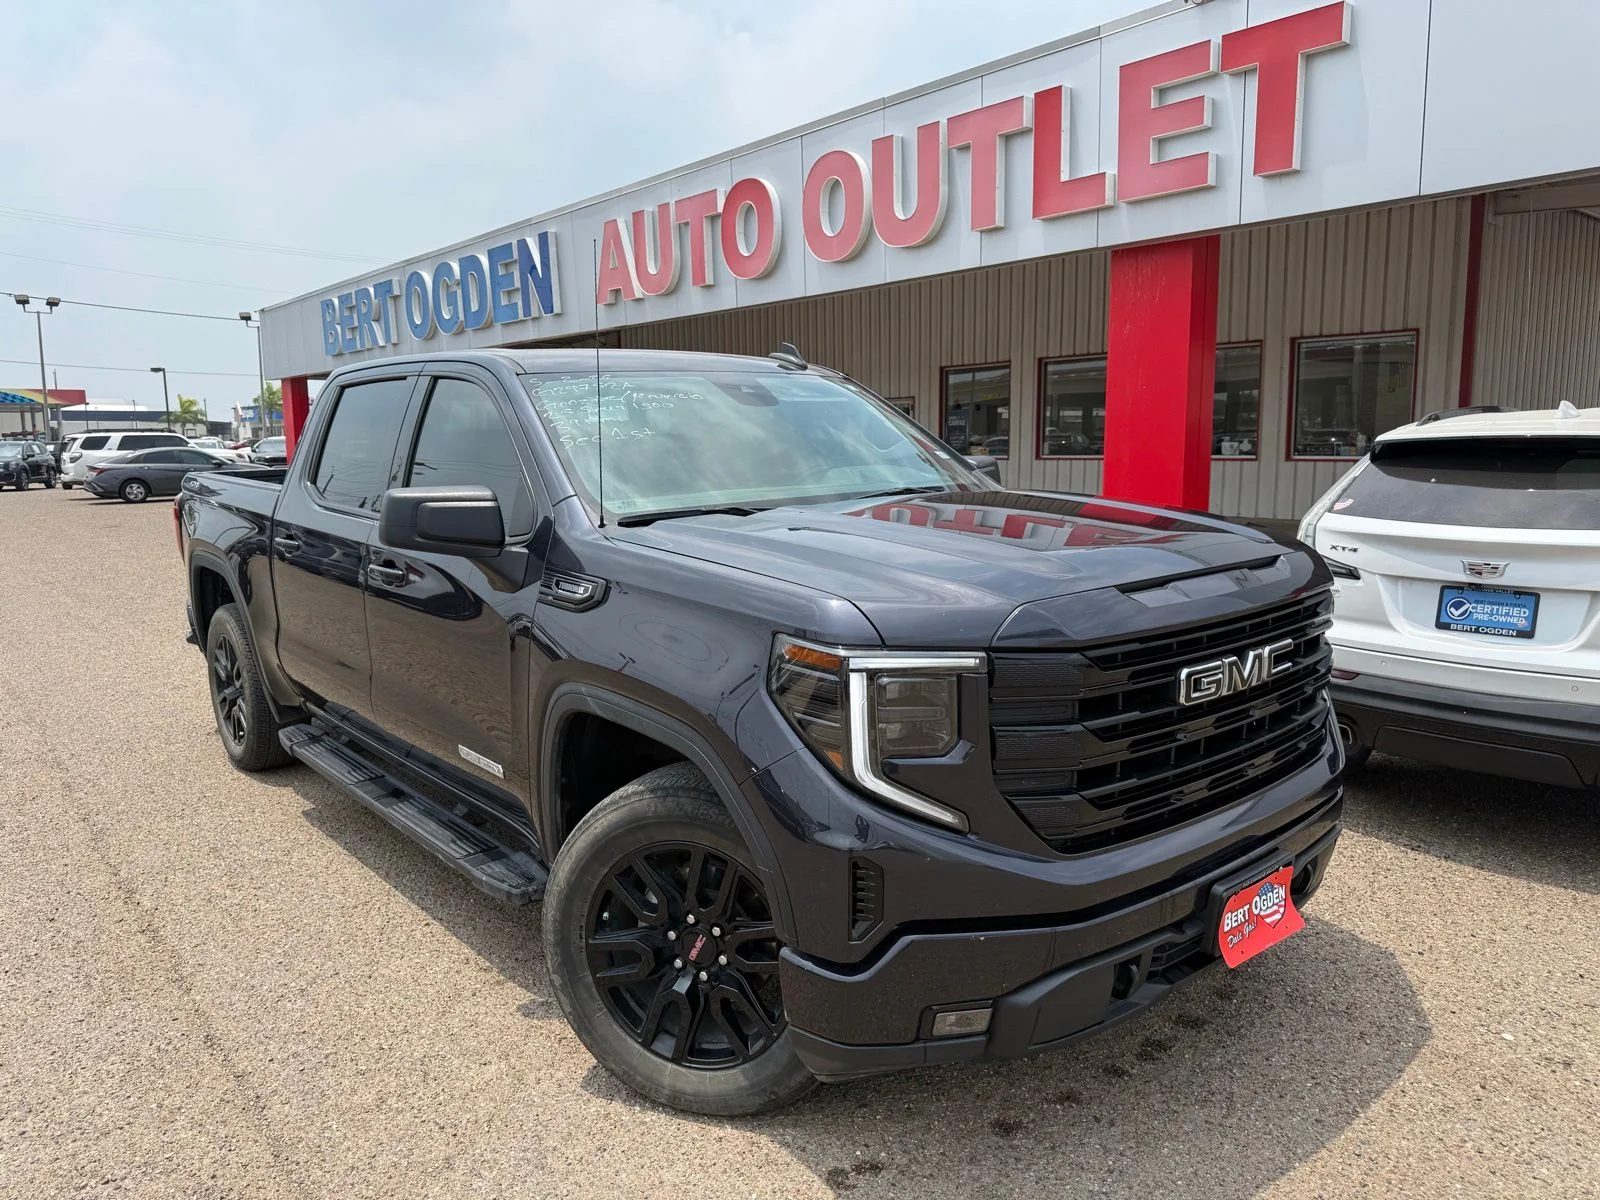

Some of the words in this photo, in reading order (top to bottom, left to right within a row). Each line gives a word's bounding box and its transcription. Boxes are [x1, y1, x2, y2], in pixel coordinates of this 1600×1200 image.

[320, 279, 400, 356] BERT
[405, 231, 562, 340] OGDEN
[597, 177, 782, 305] AUTO
[802, 1, 1352, 263] OUTLET
[1330, 545, 1359, 553] XT4
[1469, 603, 1529, 617] CERTIFIED
[1473, 612, 1525, 624] PRE-OWNED
[1450, 623, 1477, 632] BERT
[1478, 626, 1517, 636] OGDEN
[1179, 638, 1294, 706] GMC
[1224, 904, 1250, 933] BERT
[1252, 884, 1286, 916] OGDEN
[688, 934, 707, 961] GMC
